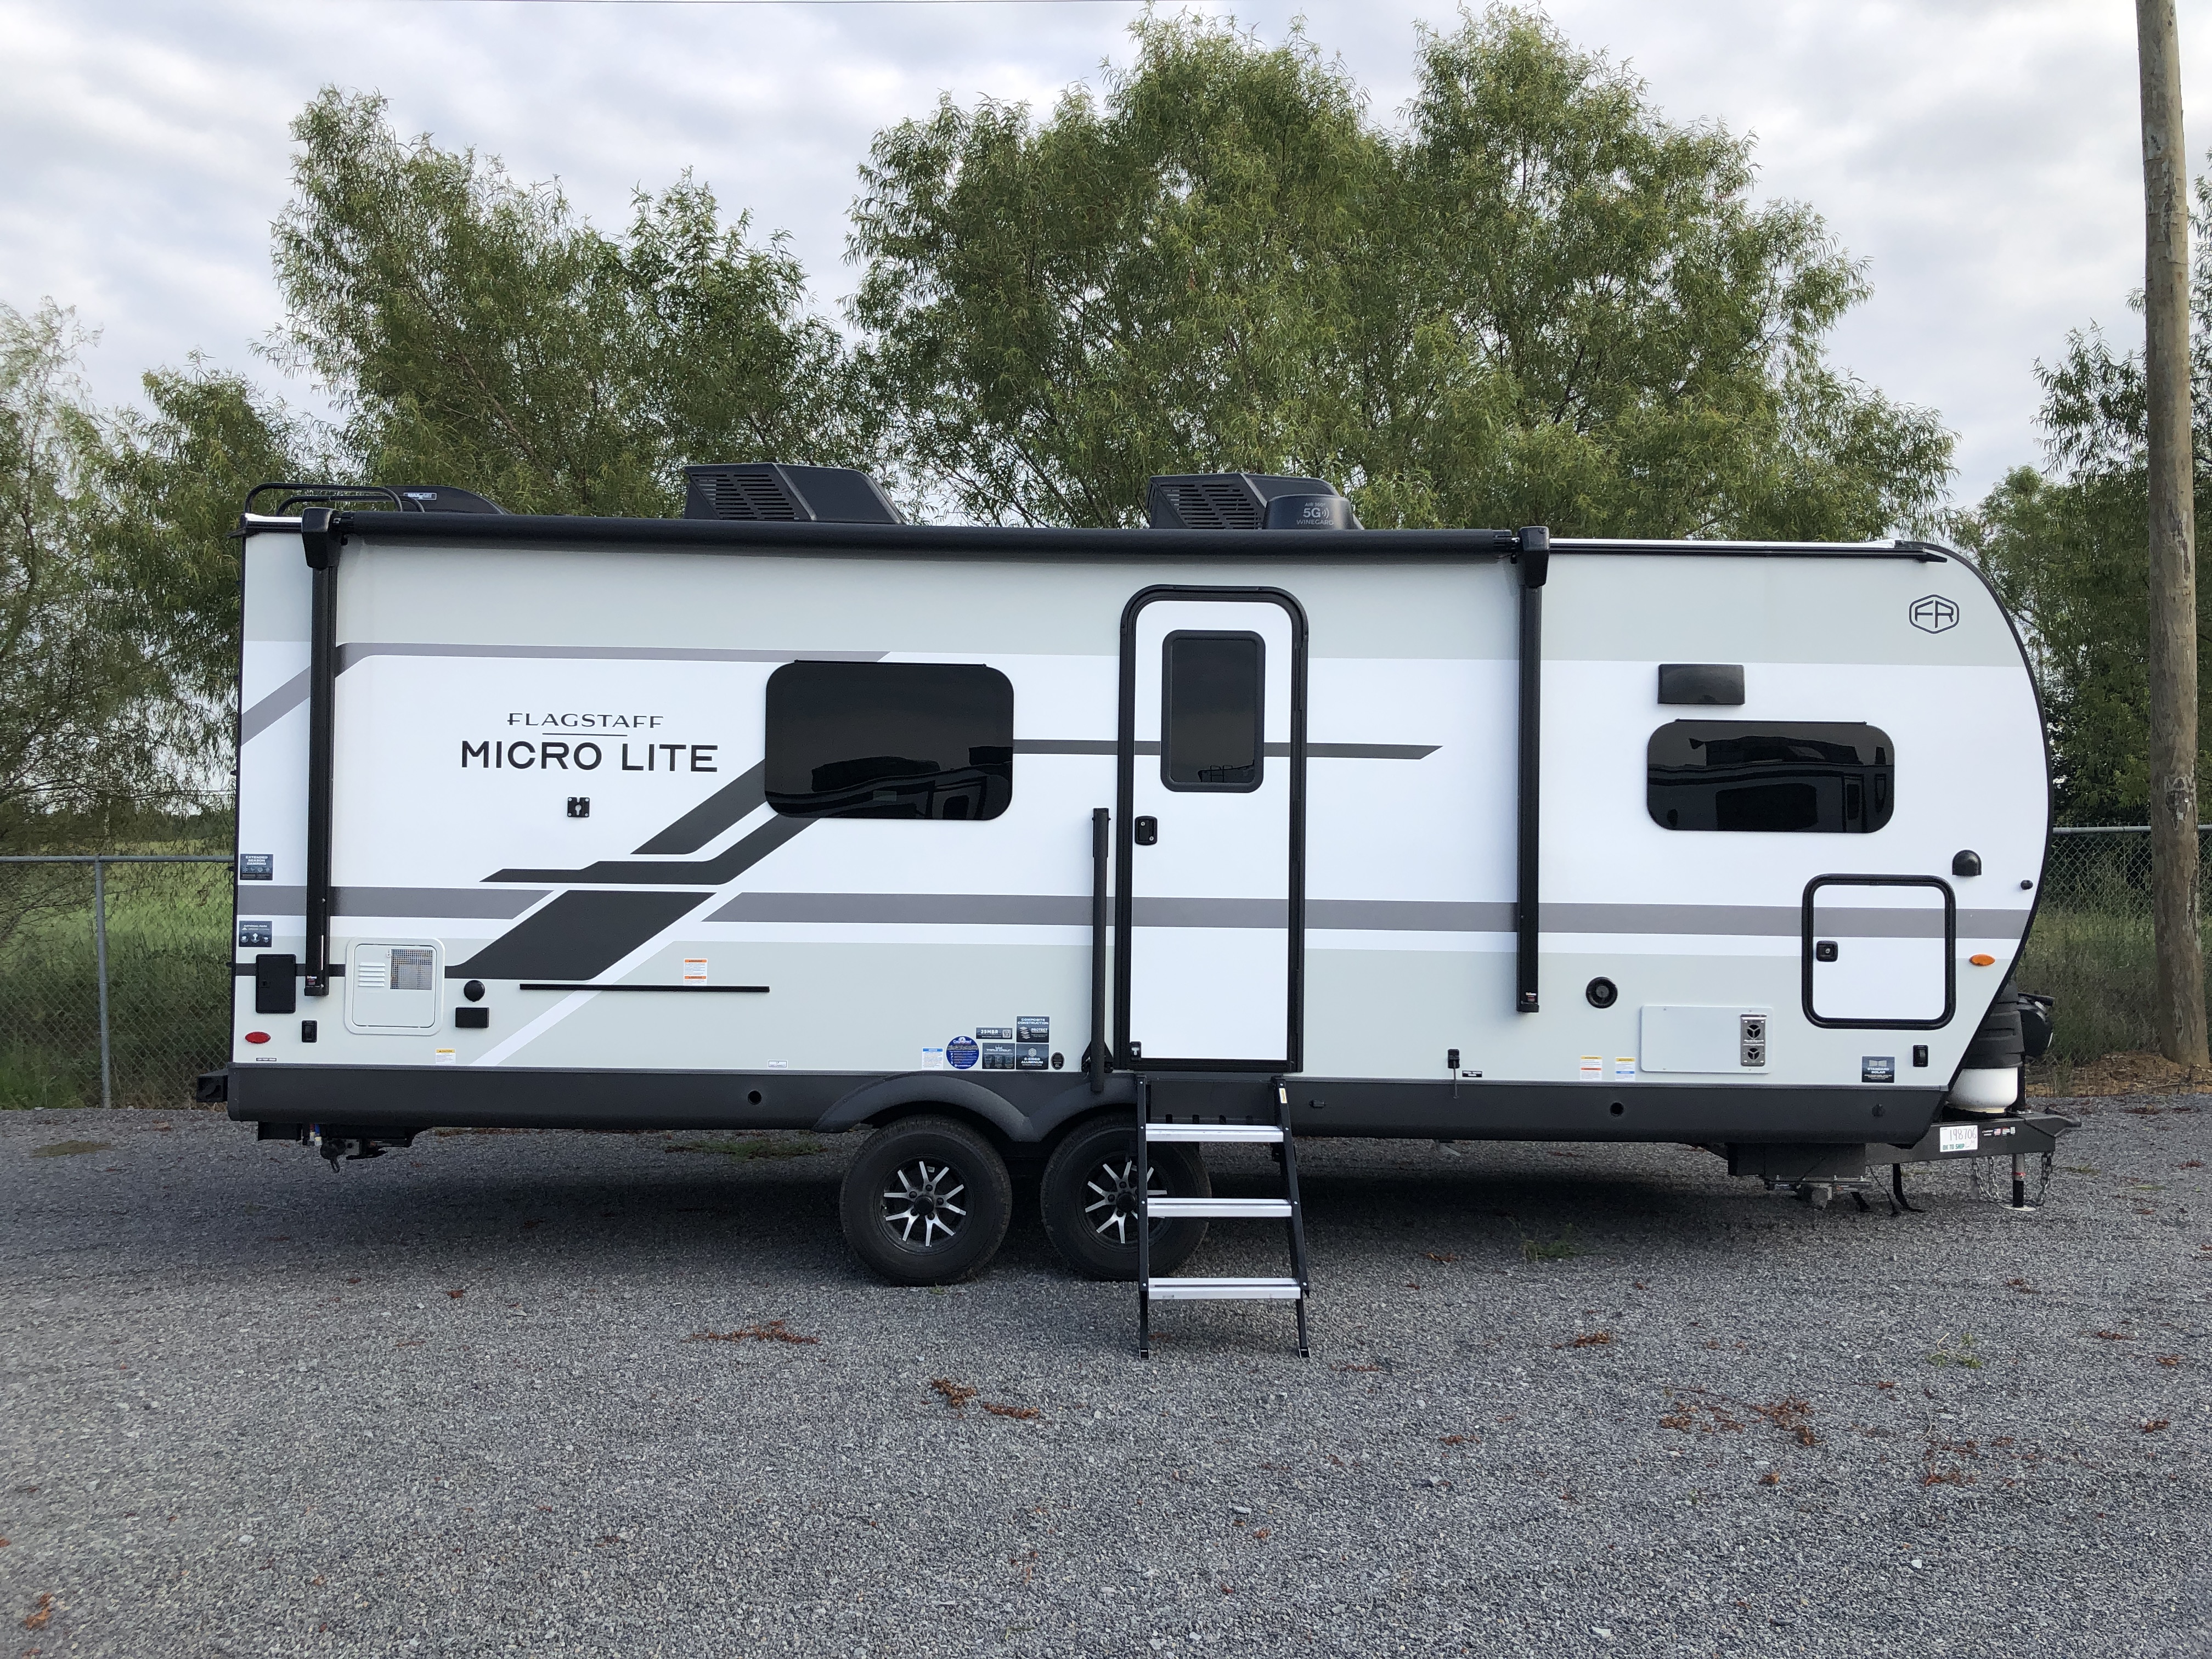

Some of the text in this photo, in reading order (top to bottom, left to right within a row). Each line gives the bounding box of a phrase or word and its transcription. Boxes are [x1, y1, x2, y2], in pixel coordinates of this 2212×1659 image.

[1303, 507, 1321, 518] 5G
[1915, 600, 1954, 628] FR
[507, 713, 664, 729] FLAGSTAFF
[461, 740, 718, 772] MICRO LITE
[1950, 1127, 1977, 1141] 198706
